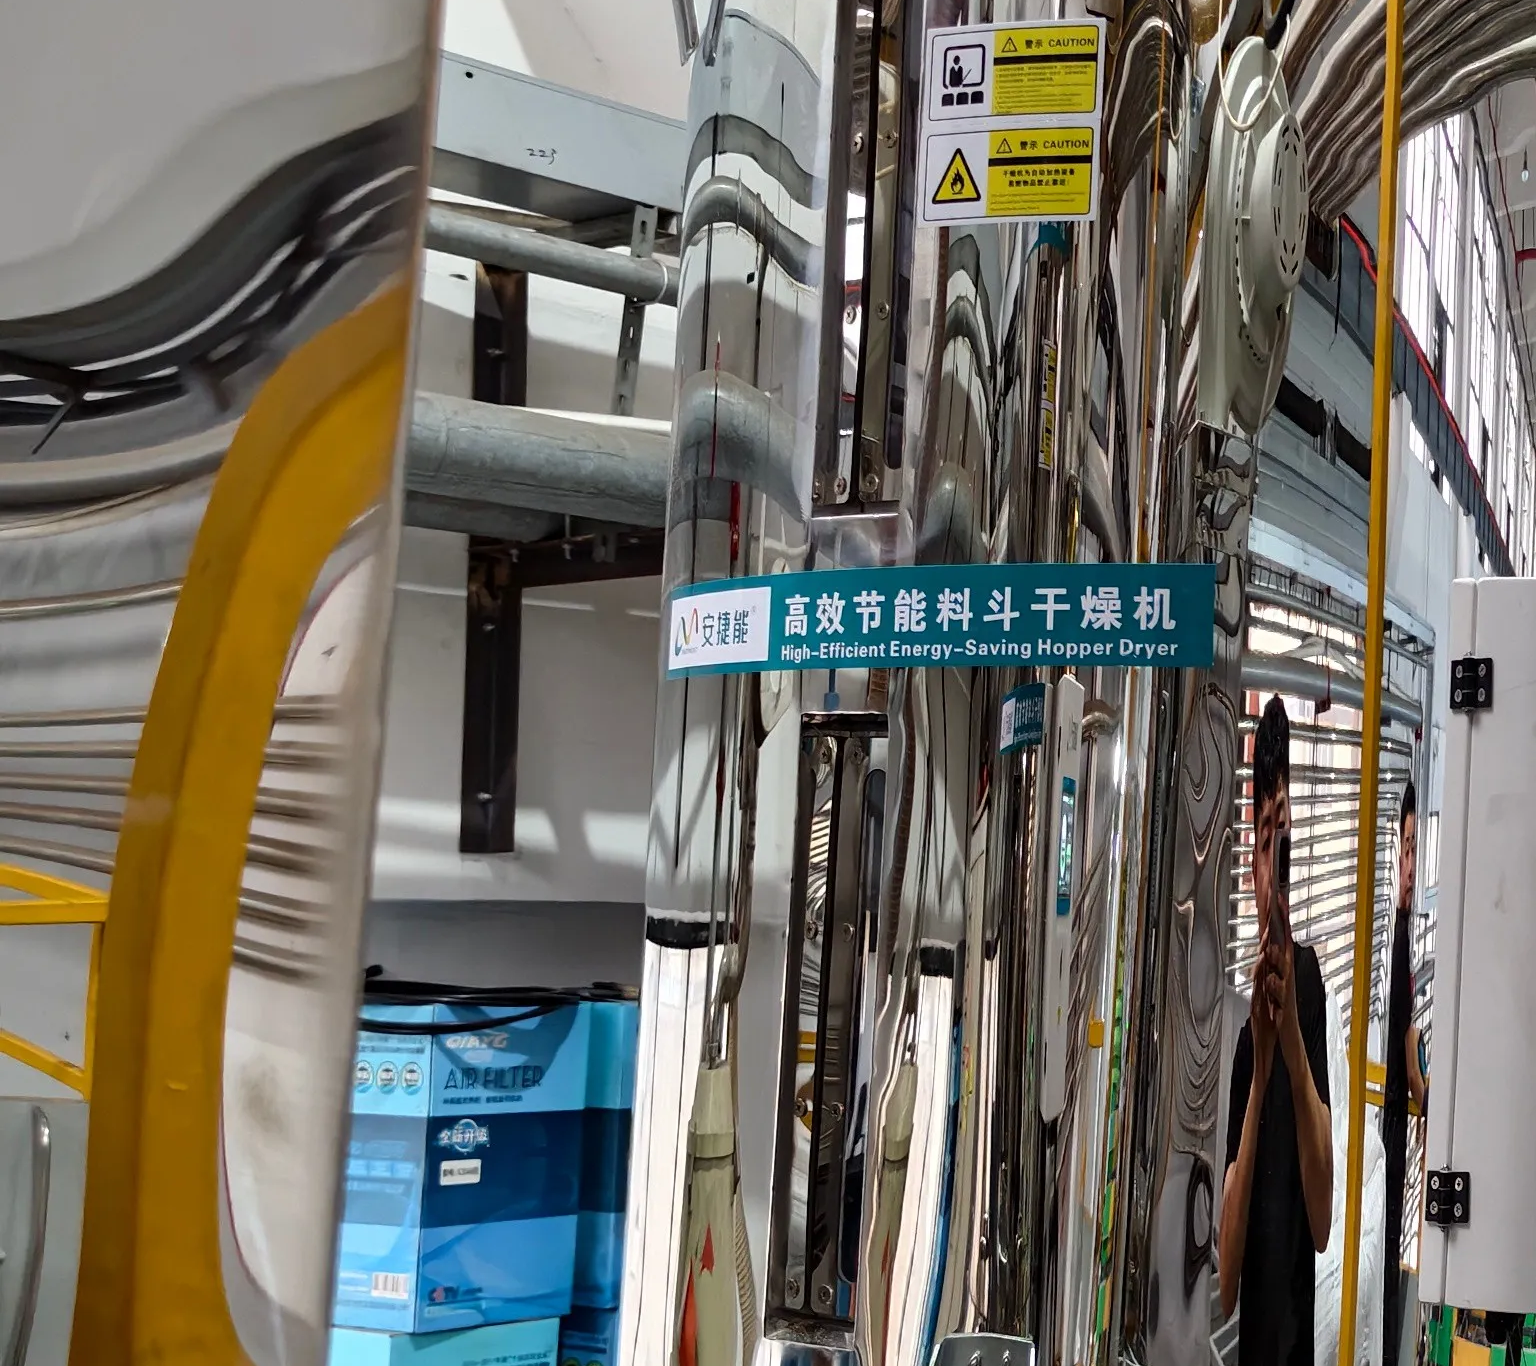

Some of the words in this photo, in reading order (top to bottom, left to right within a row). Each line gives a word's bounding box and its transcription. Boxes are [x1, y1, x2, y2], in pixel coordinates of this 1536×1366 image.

[1047, 37, 1096, 48] CAUTION
[1043, 139, 1090, 149] CAUTION
[785, 586, 1177, 637] 高效节能料斗干燥机
[702, 609, 750, 648] 安捷能
[781, 641, 886, 664] High-Efficient
[890, 638, 1032, 660] Energy-Saving
[1037, 638, 1114, 659] Hopper
[1119, 638, 1179, 660] Dryer
[444, 1067, 478, 1090] AIR
[484, 1065, 544, 1089] FILTER
